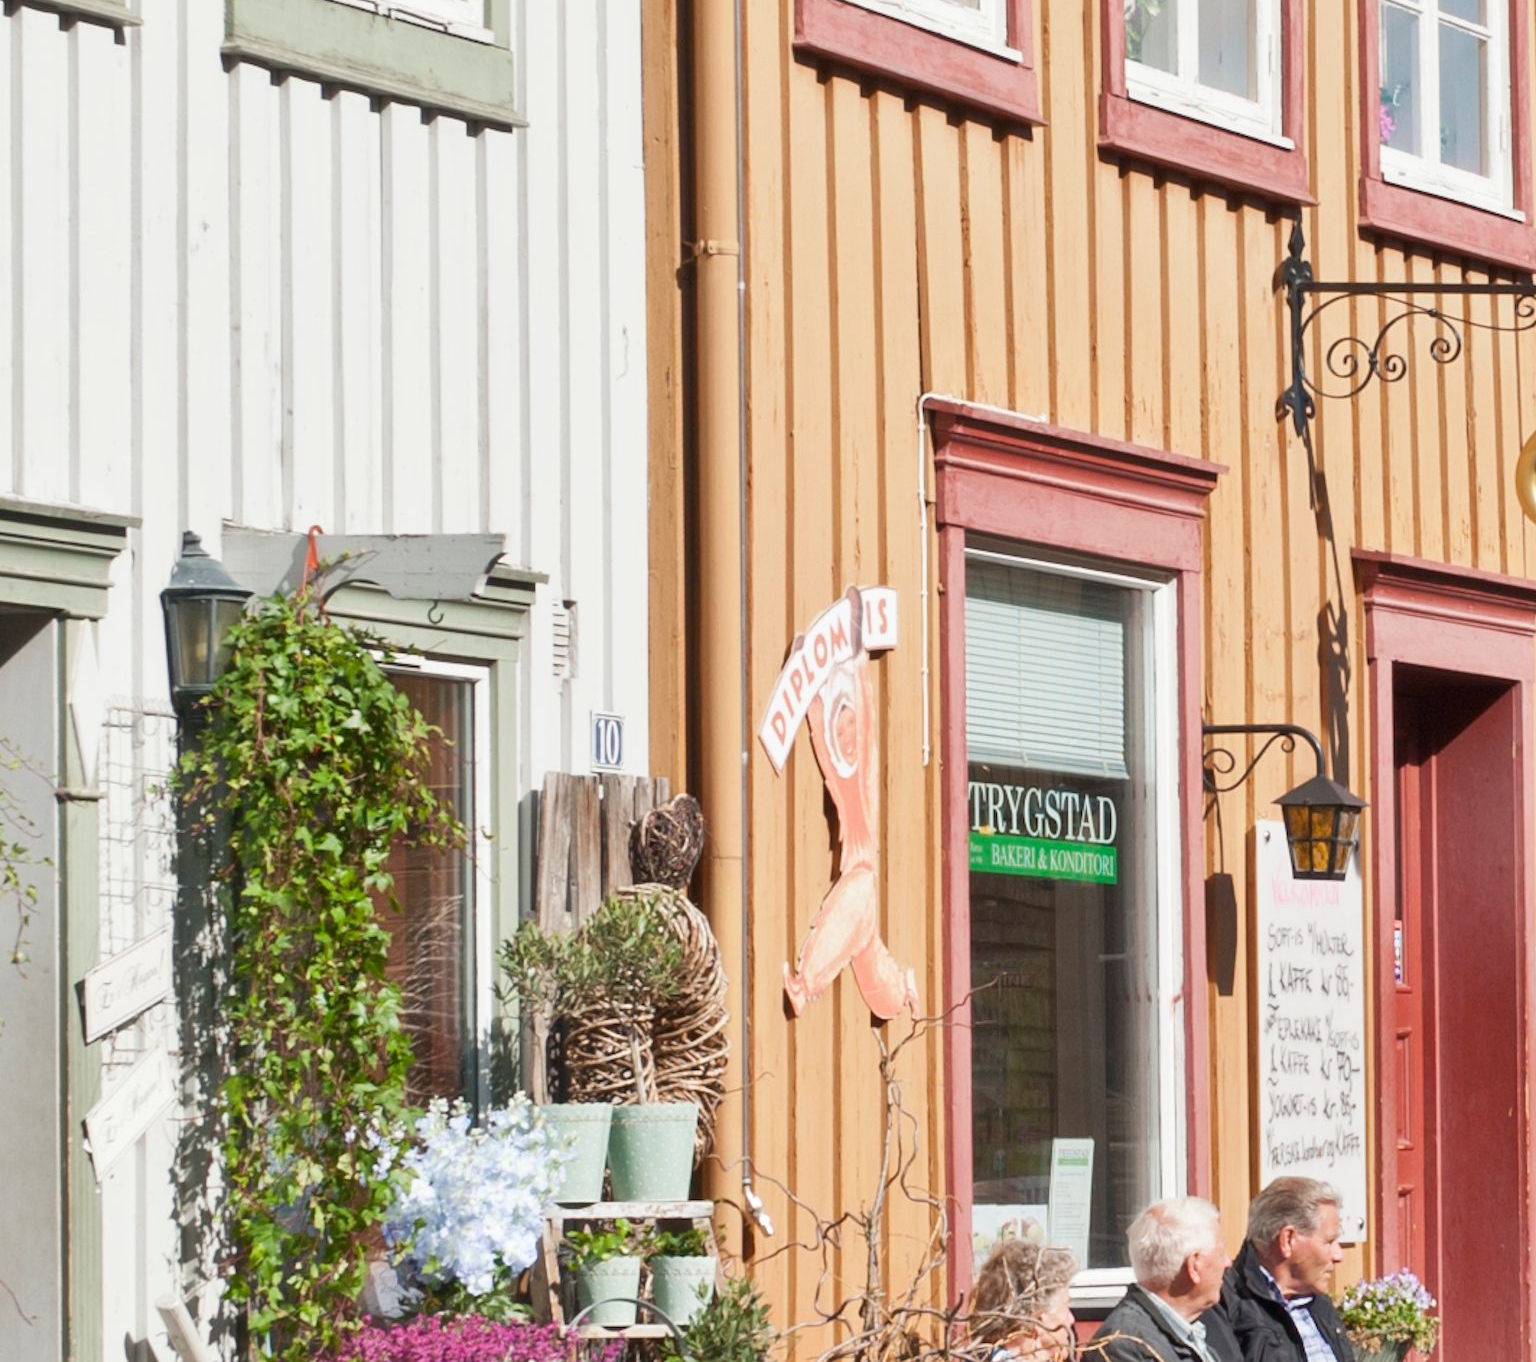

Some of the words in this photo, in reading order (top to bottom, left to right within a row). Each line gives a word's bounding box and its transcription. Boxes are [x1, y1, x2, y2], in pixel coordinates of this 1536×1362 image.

[770, 616, 849, 746] DIPLOM
[866, 598, 888, 635] IS
[597, 718, 620, 765] 10
[968, 780, 1117, 845] TRYGSTAD
[991, 842, 1036, 869] BAKERI
[1038, 847, 1048, 870] &
[1050, 849, 1115, 878] KONDITORI
[1279, 962, 1314, 993] KAFFE
[1280, 1045, 1311, 1075] KAFFE
